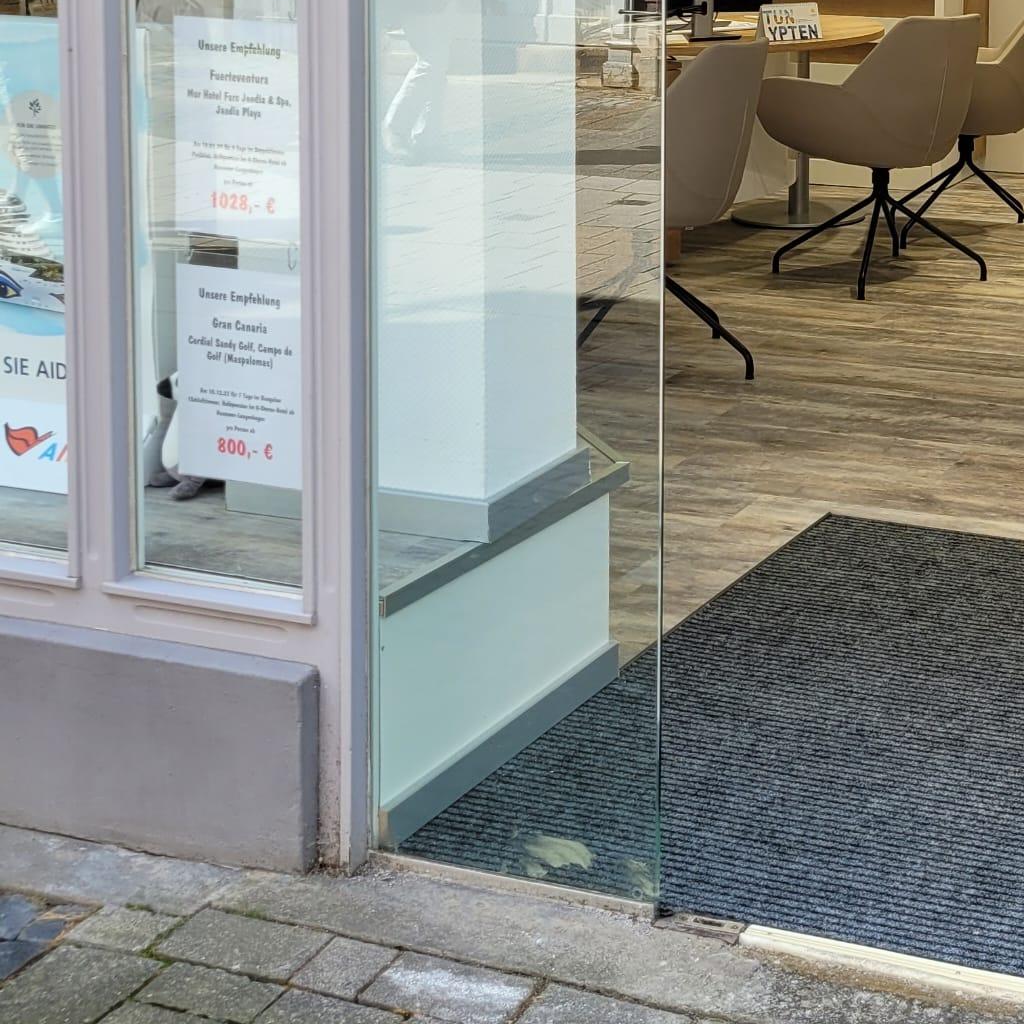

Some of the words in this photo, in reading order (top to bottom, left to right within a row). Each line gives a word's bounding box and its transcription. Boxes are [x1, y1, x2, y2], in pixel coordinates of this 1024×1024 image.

[768, 24, 819, 41] YPTEN
[198, 40, 227, 52] Unsere
[230, 41, 281, 59] Empfehlung
[209, 69, 269, 85] Fuerteventura
[210, 191, 260, 214] 1028,-
[266, 197, 275, 214] €
[198, 288, 227, 301] Unsere
[230, 291, 281, 309] Empfehlung
[212, 317, 232, 330] Gran
[235, 320, 268, 334] Canaria
[207, 351, 222, 361] Golf
[3, 356, 29, 376] SIE
[217, 437, 258, 459] 800,-
[264, 443, 273, 460] €
